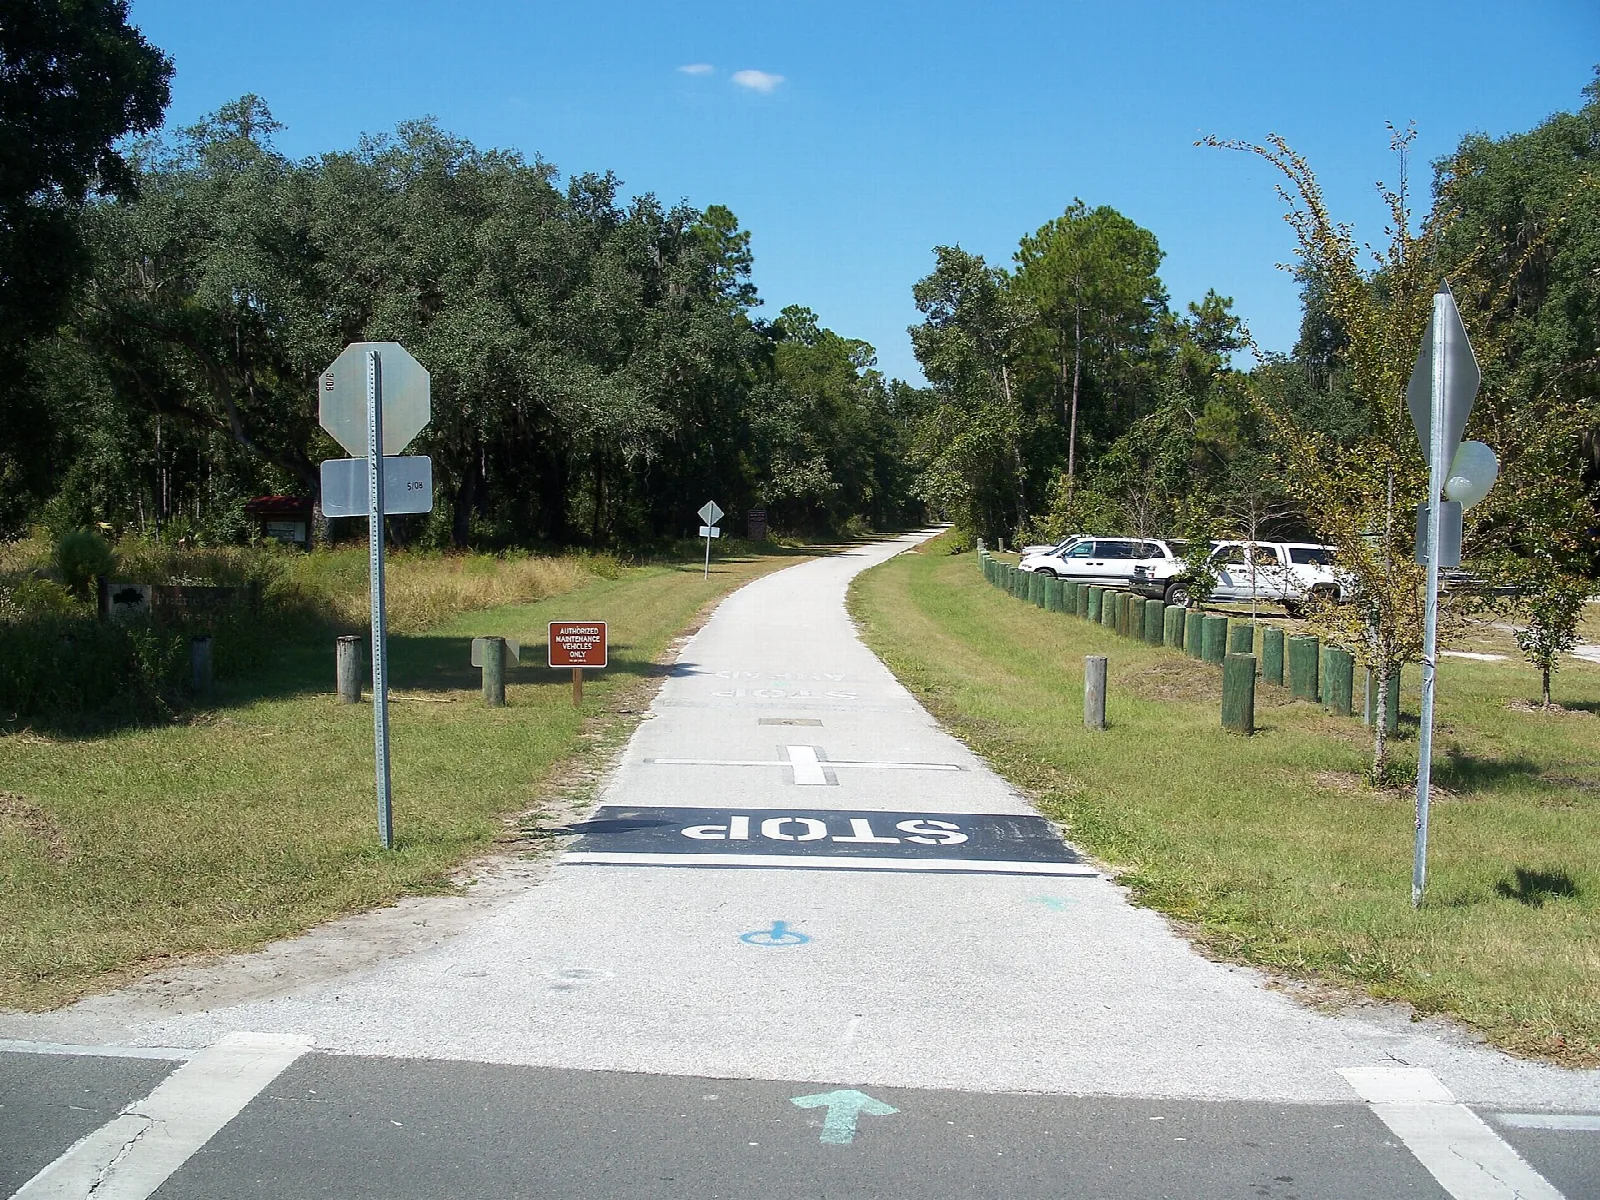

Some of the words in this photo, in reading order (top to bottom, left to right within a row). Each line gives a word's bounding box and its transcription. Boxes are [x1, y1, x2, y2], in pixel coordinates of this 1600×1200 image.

[560, 627, 599, 635] AUTHORIZED
[555, 635, 601, 643] MAINTENANCE
[681, 816, 969, 846] STOP
